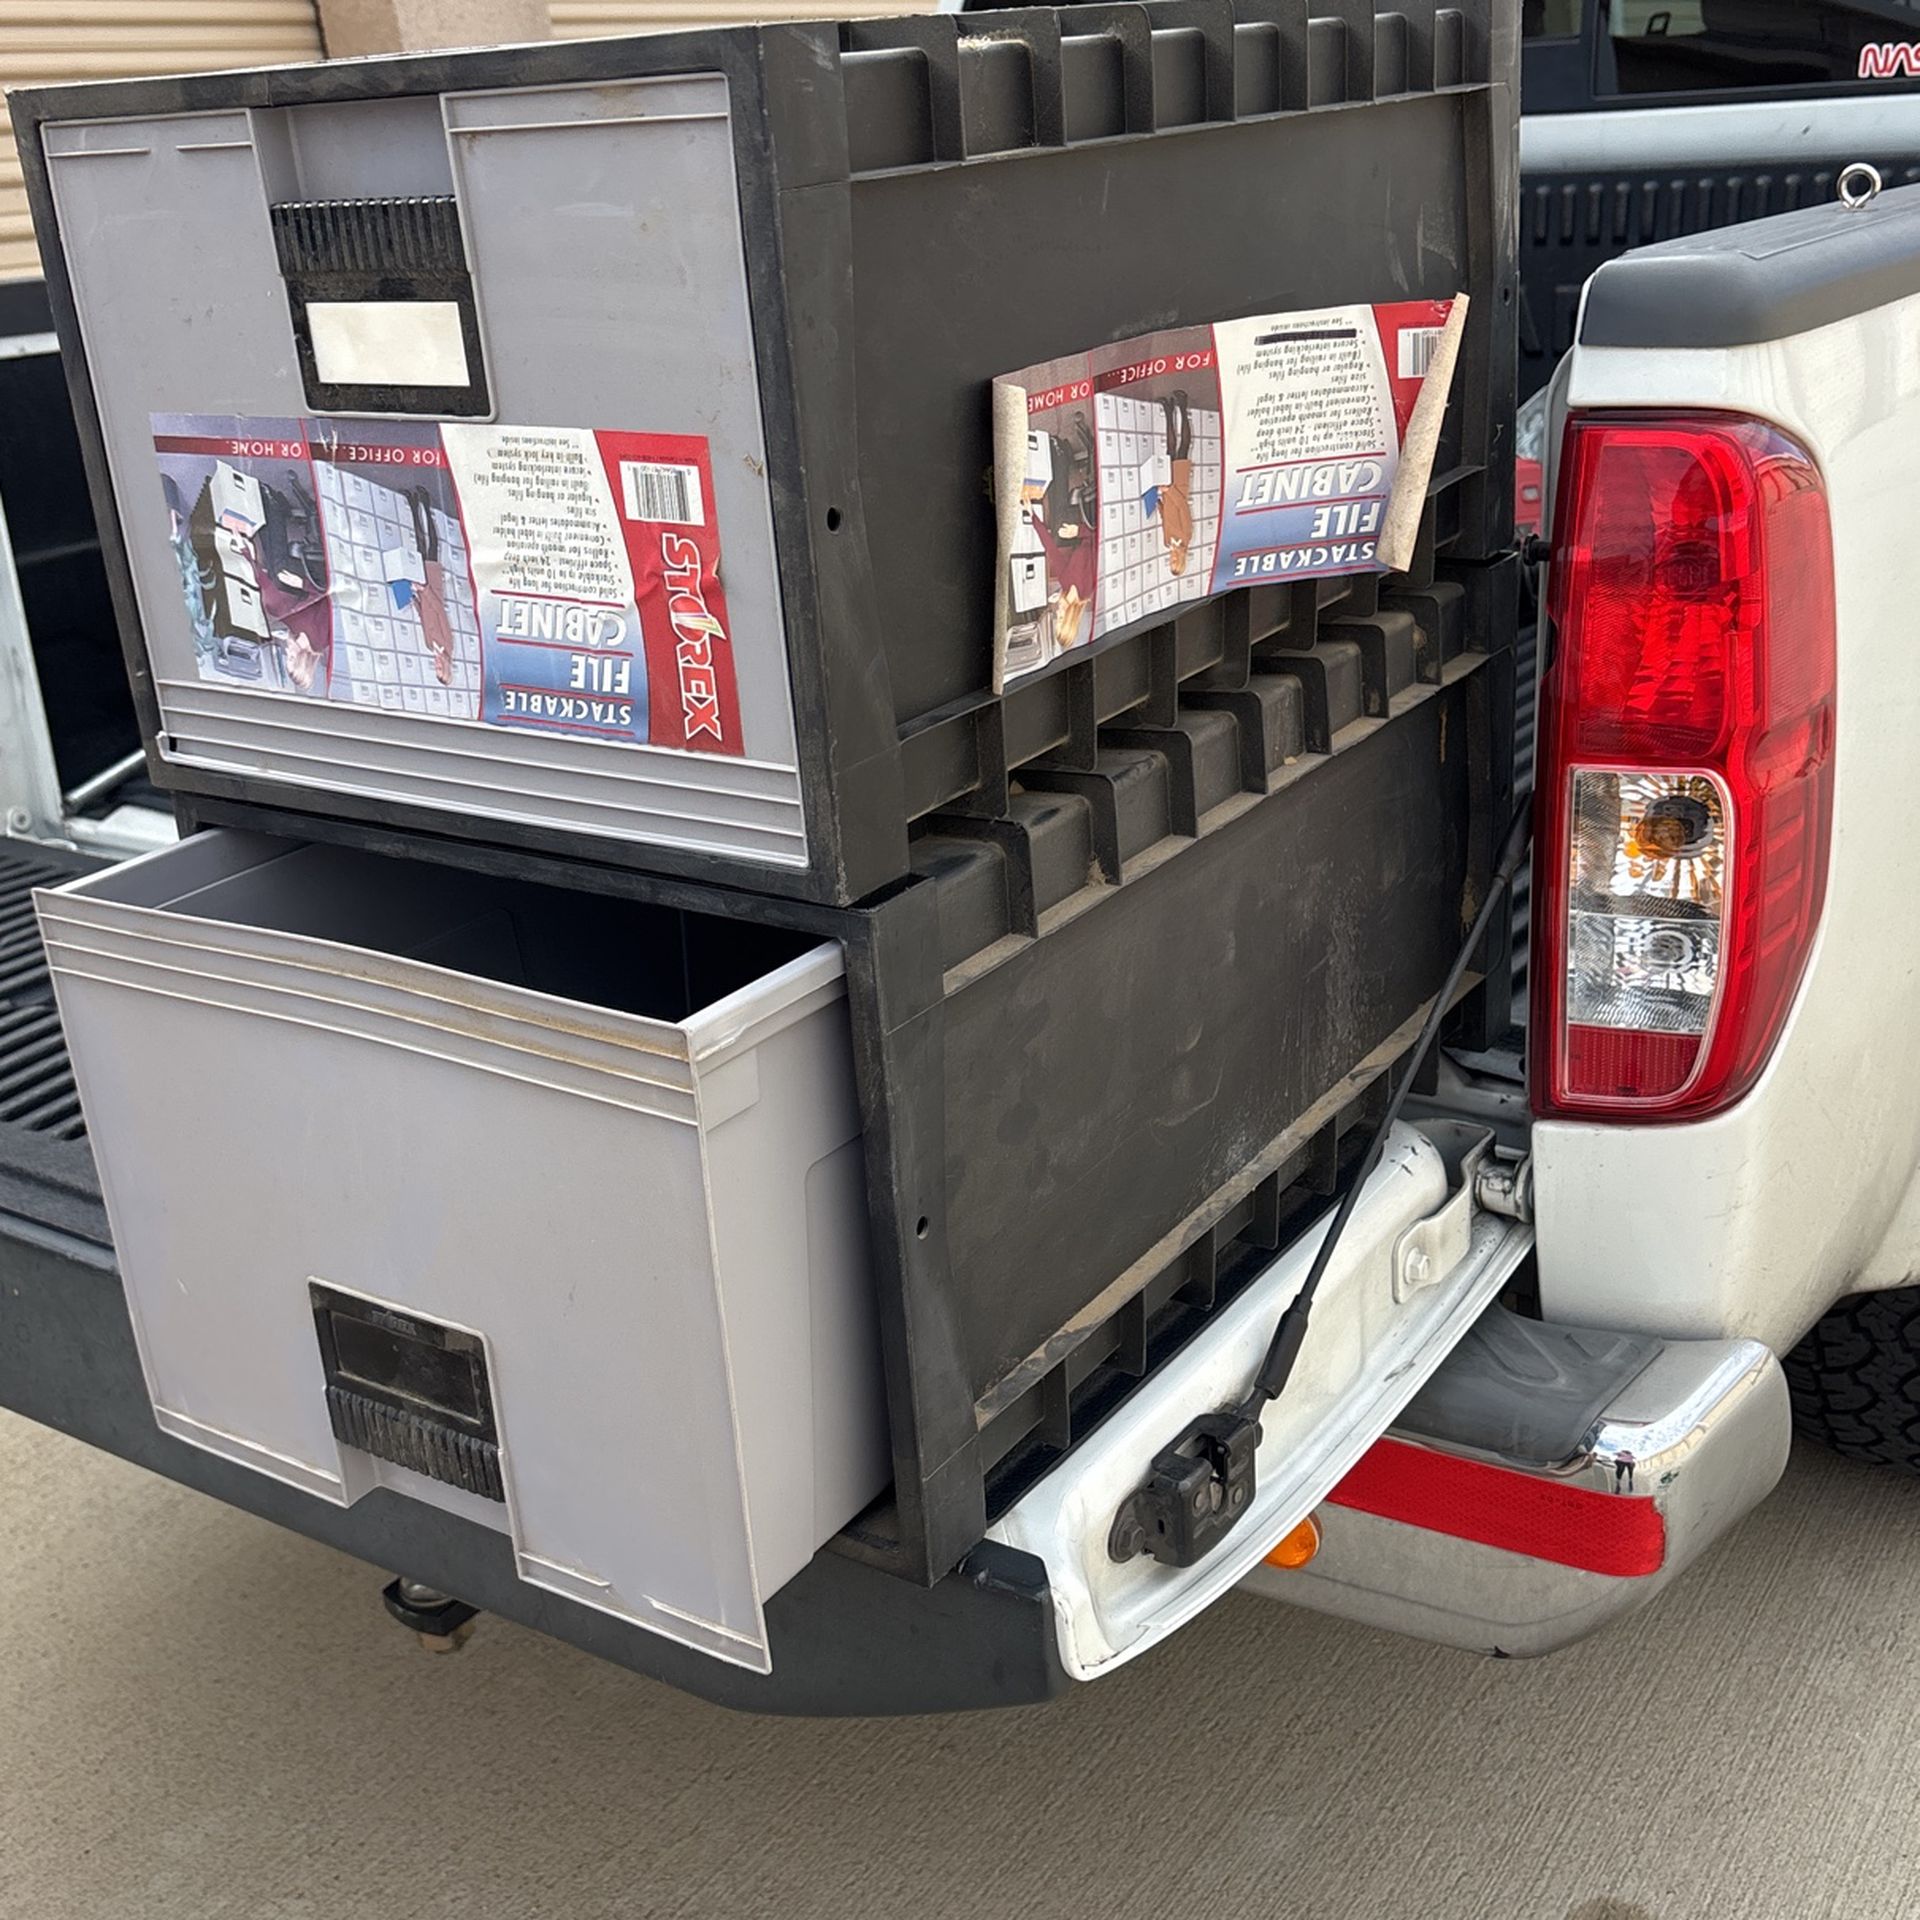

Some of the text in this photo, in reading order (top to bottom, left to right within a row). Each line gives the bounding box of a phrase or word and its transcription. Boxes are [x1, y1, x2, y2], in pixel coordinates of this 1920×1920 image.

[1332, 318, 1342, 326] See
[1256, 339, 1358, 357] Secure interlocking system
[1175, 353, 1210, 368] FOR
[1300, 354, 1326, 364] railing
[1339, 350, 1361, 362] (Built
[1254, 359, 1284, 370] hanging
[1286, 358, 1298, 367] for
[1334, 361, 1364, 373] Regular
[1269, 371, 1285, 381] files
[1288, 366, 1319, 377] hanging
[1331, 373, 1366, 385] size files
[1071, 382, 1089, 397] OR
[1256, 384, 1368, 406] Accommodates letter & legal
[1326, 395, 1370, 407] Convenient
[1247, 407, 1270, 417] holder
[1273, 404, 1292, 414] label
[1259, 407, 1372, 426] Rollers for smooth operation
[1313, 421, 1347, 433] efficient
[1351, 418, 1373, 429] Space
[1256, 428, 1274, 438] deep
[1277, 427, 1292, 436] inch
[1295, 425, 1305, 434] 24
[522, 438, 557, 447] instructions
[1300, 436, 1309, 445] 10
[1313, 435, 1321, 444] to
[1324, 432, 1333, 442] up
[560, 439, 570, 448] See
[1278, 438, 1296, 449] units
[281, 443, 301, 457] OR
[498, 449, 521, 458] system
[525, 450, 538, 461] lock
[541, 450, 554, 461] key
[1256, 440, 1376, 463] Solid construction for long life
[412, 450, 440, 465] FOR
[492, 462, 516, 470] system
[519, 461, 561, 474] interlocking
[492, 473, 520, 485] hanging
[523, 478, 533, 486] for
[536, 476, 559, 488] railing
[1235, 461, 1382, 508] CABINET
[508, 490, 523, 501] files
[526, 489, 555, 502] hanging
[567, 506, 583, 518] files
[501, 512, 519, 525] legal
[521, 516, 525, 525] &
[529, 517, 548, 527] letter
[1311, 501, 1380, 538] FILE
[493, 527, 516, 538] holder
[518, 529, 535, 540] label
[507, 540, 539, 552] operation
[569, 547, 581, 558] for
[540, 556, 550, 566] 24
[1234, 542, 1375, 576] STACKABLE
[590, 560, 612, 572] Space
[528, 567, 545, 578] units
[547, 569, 556, 580] 10
[579, 573, 614, 585] Stackable
[509, 577, 617, 598] Solid construction for long life
[496, 599, 626, 646] CABINET
[662, 533, 726, 741] STOREX
[570, 654, 630, 694] FILE
[505, 691, 632, 725] STACKABLE
